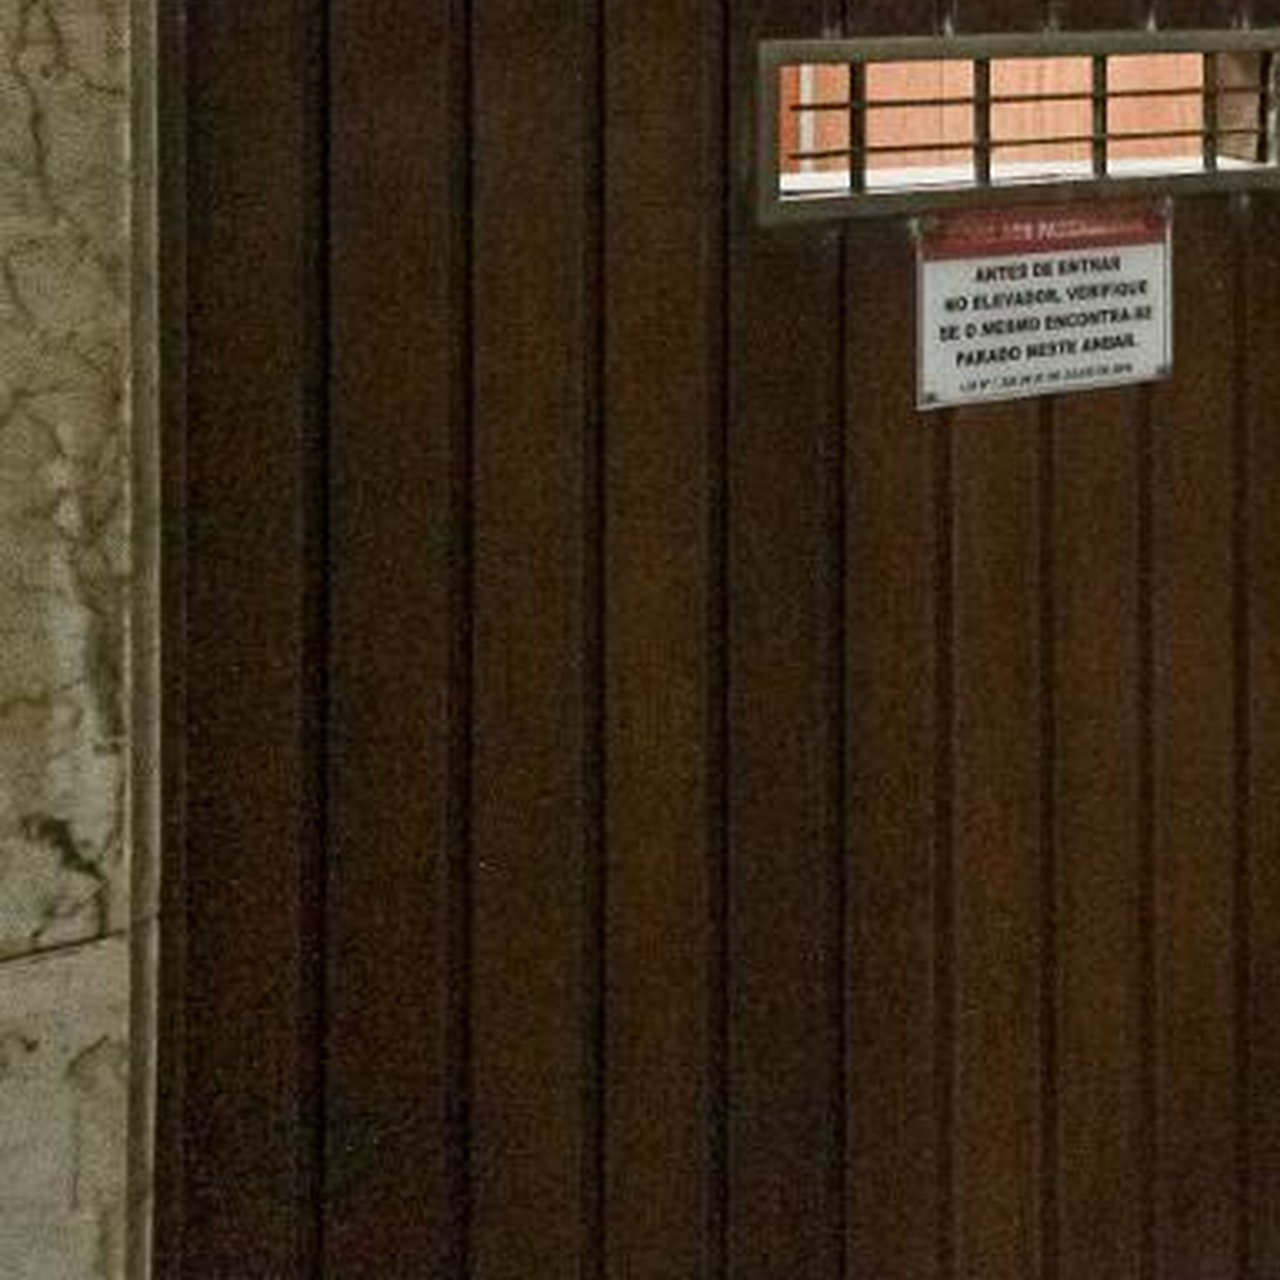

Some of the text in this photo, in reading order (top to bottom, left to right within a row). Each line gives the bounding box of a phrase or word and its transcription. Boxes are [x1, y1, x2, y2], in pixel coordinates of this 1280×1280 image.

[974, 255, 1122, 283] ANTES DE ENTRAR
[944, 296, 969, 313] NO
[1066, 279, 1149, 302] VERIFIQUE
[938, 326, 961, 343] SE
[965, 323, 978, 339] O
[982, 315, 1042, 337] MESMO
[956, 346, 1022, 367] PARADO
[1026, 337, 1078, 360] NESTE
